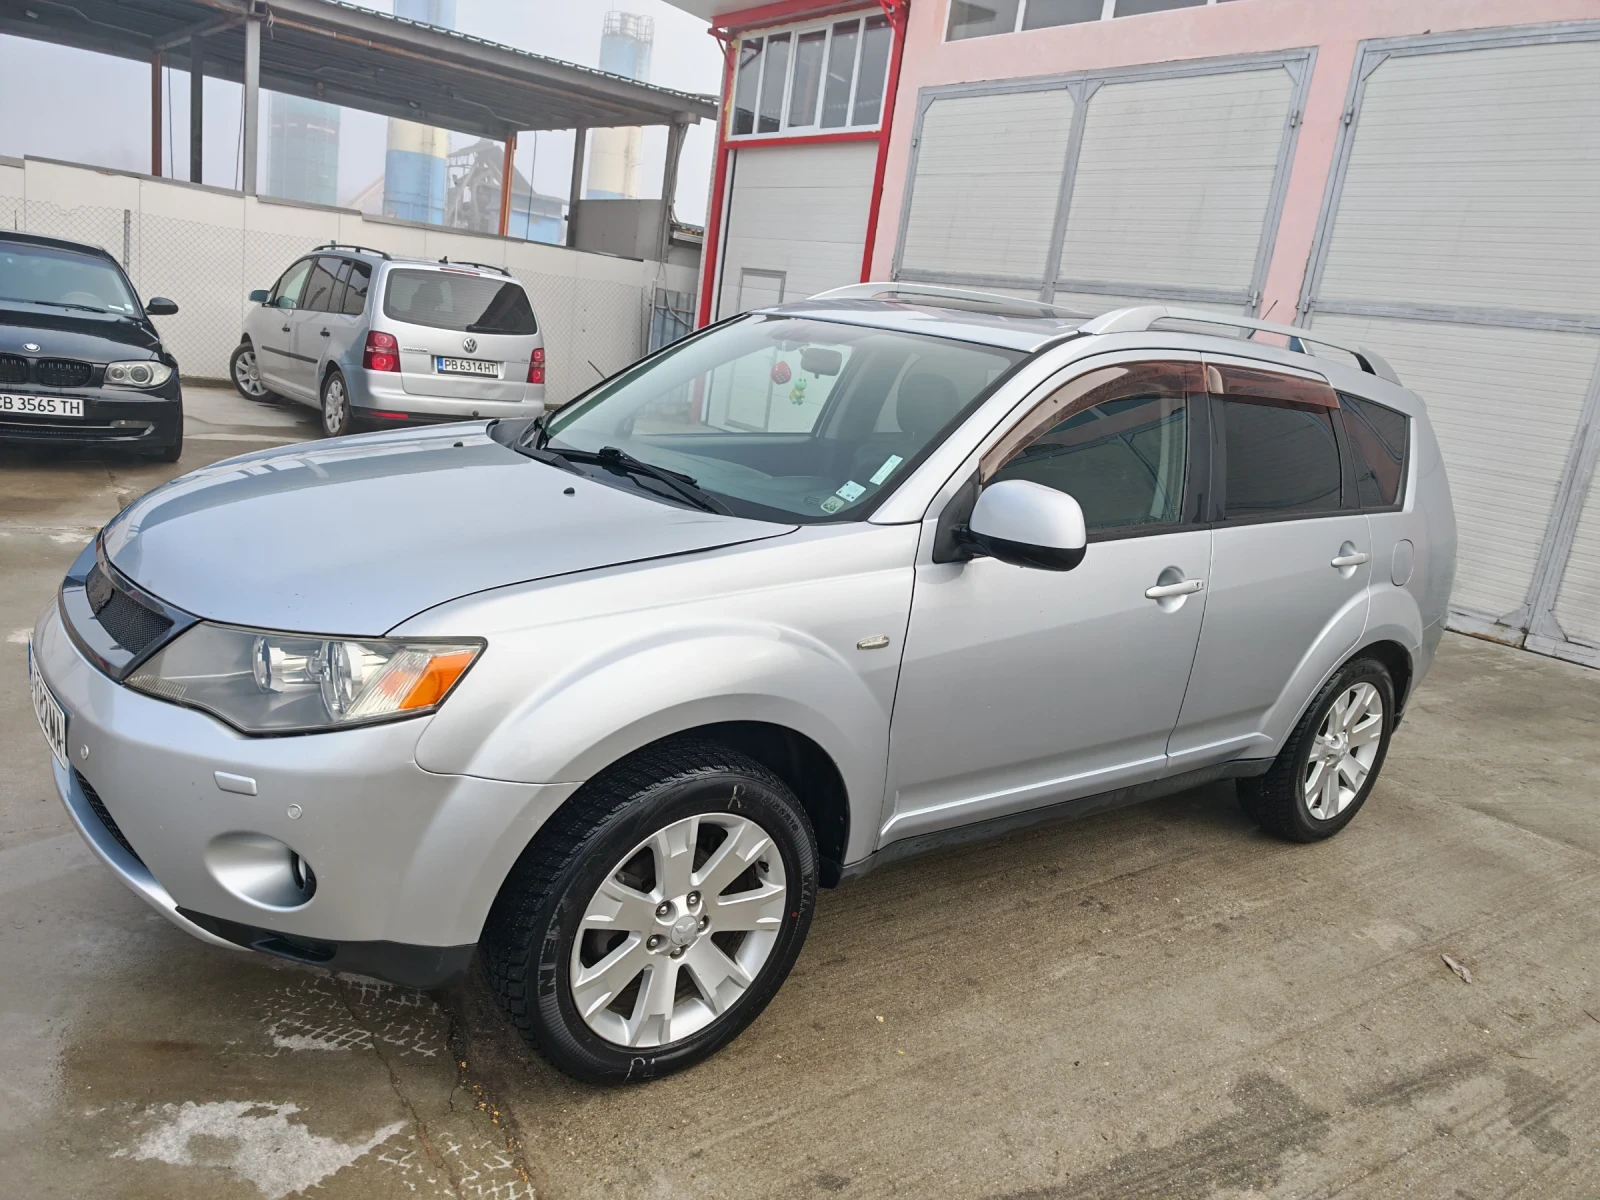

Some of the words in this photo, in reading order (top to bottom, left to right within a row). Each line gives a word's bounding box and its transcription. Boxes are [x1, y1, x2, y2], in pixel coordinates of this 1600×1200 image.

[444, 359, 459, 370] PB
[459, 360, 483, 373] 6314
[483, 362, 497, 374] HT
[0, 396, 14, 410] B
[17, 398, 56, 412] 3565
[60, 401, 80, 414] TH
